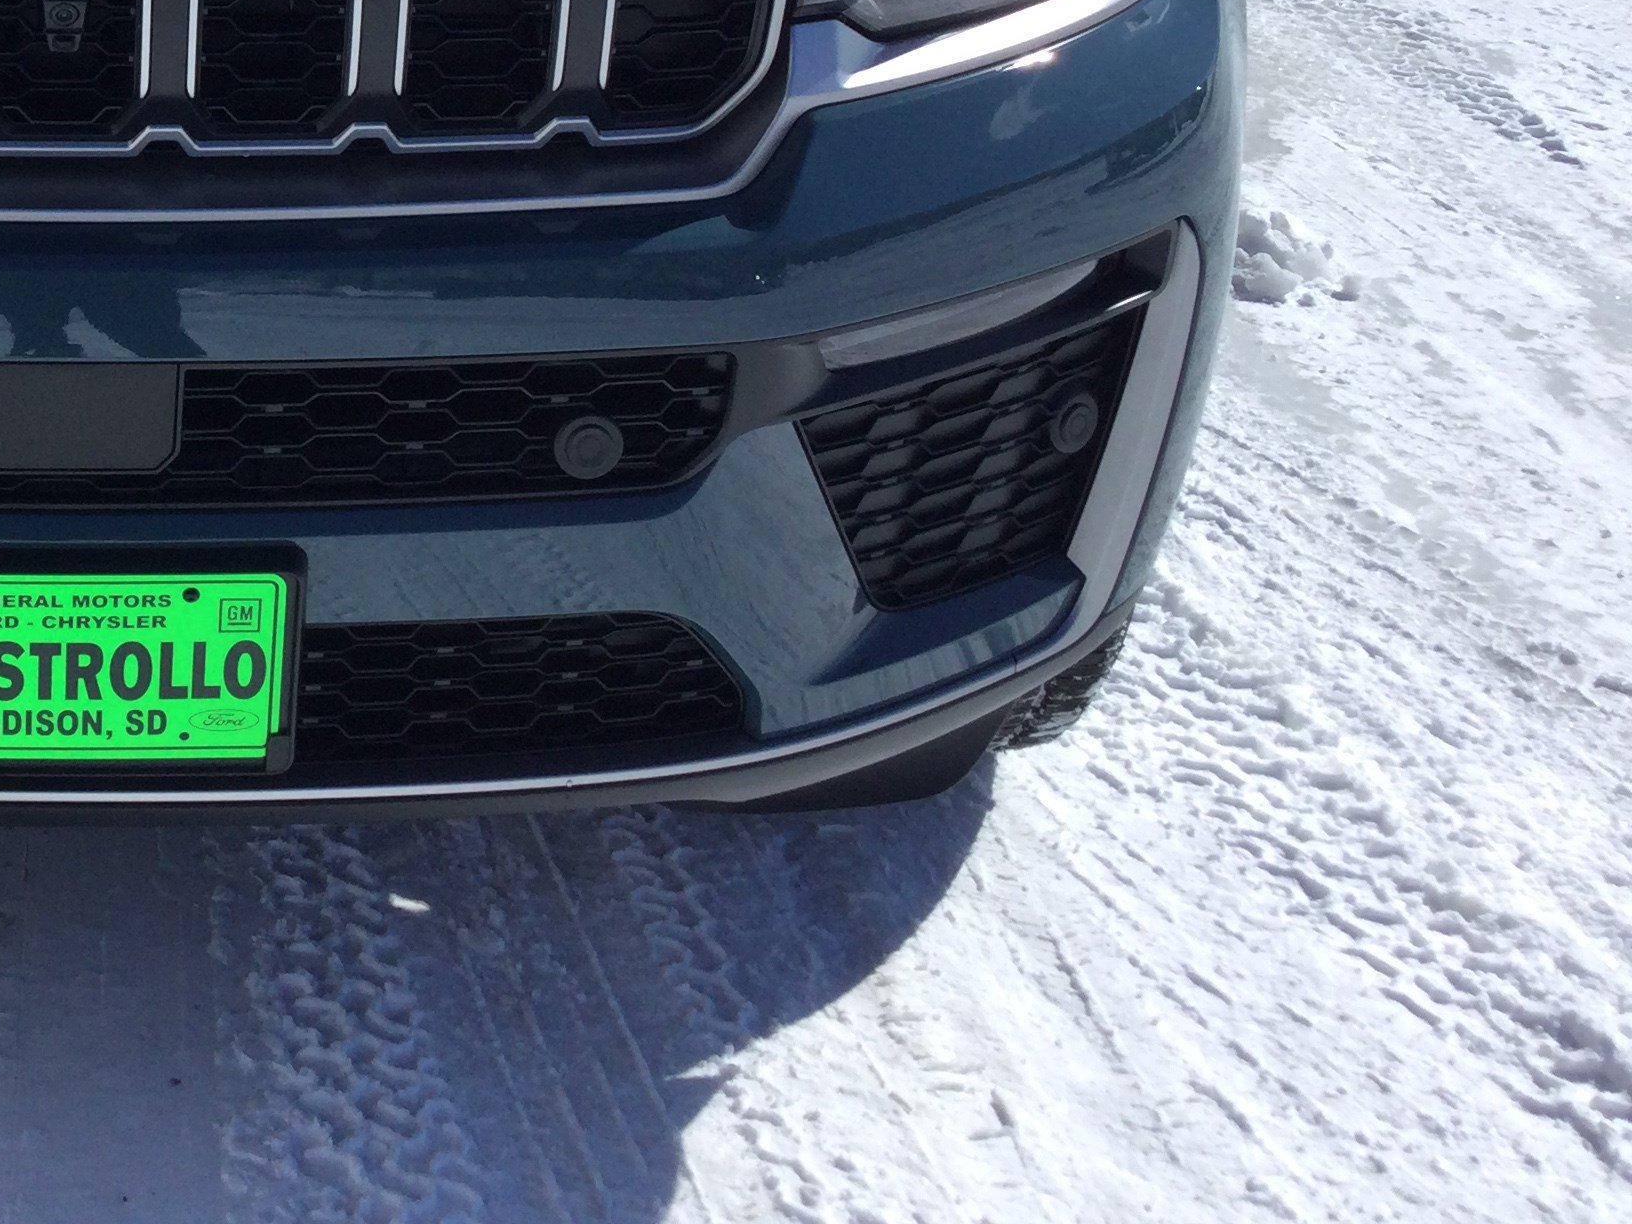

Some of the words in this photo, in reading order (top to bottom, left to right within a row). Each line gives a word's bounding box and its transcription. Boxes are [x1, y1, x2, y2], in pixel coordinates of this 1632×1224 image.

[72, 594, 171, 609] MOTORS
[227, 605, 254, 621] GM
[41, 615, 167, 629] CHRYSLER
[125, 709, 168, 736] SD
[202, 713, 245, 726] Ford
